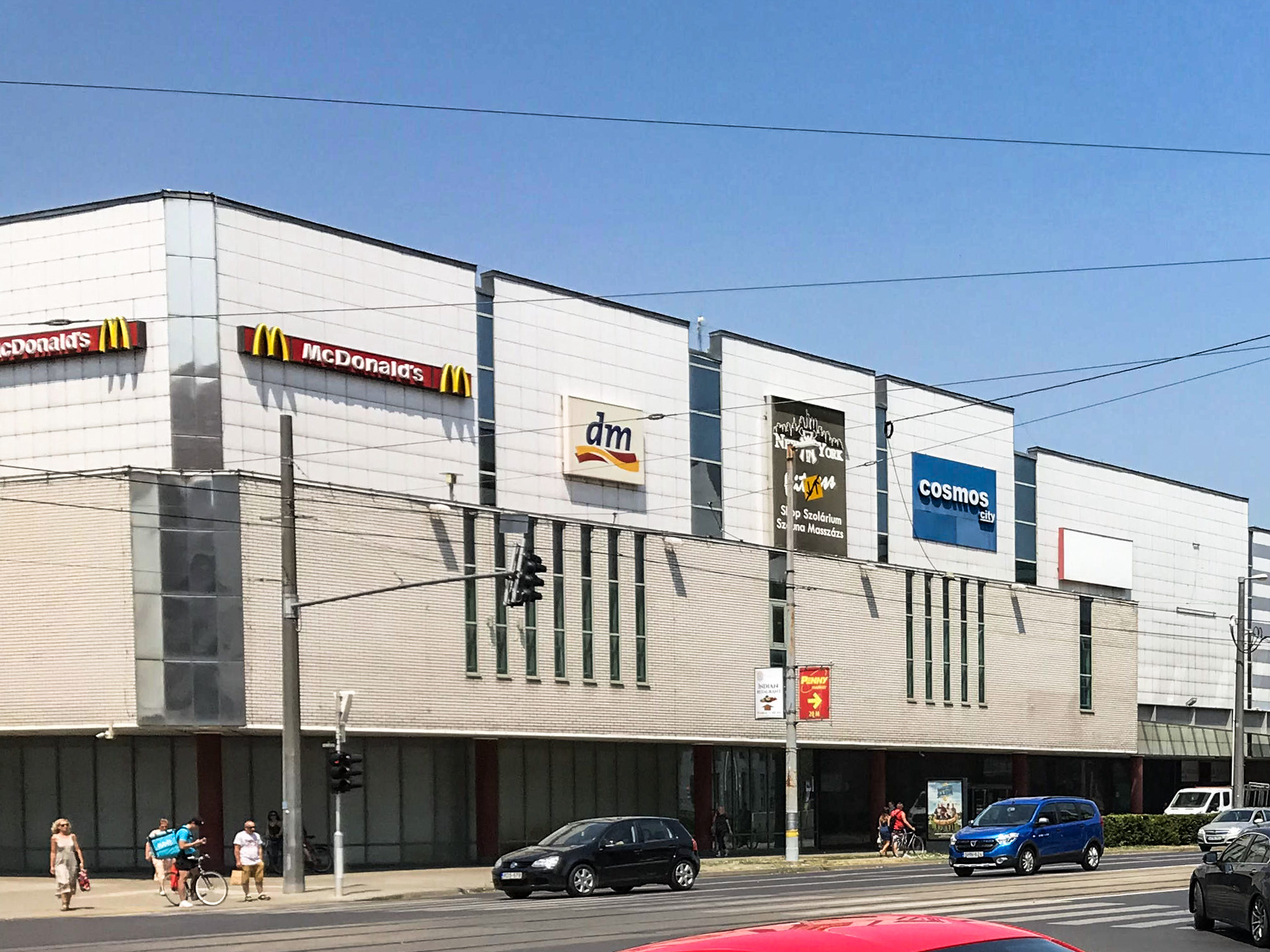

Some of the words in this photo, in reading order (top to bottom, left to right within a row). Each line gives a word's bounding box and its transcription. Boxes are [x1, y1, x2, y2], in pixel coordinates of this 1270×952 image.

[0, 331, 92, 357] cDonald's
[301, 342, 424, 383] McDonald's
[585, 411, 632, 452] dm
[818, 441, 845, 462] YORK
[918, 478, 990, 508] cosmos
[803, 508, 842, 526] Szolárium
[979, 509, 996, 524] city
[807, 522, 845, 539] Masszázs
[800, 675, 829, 686] PENNY
